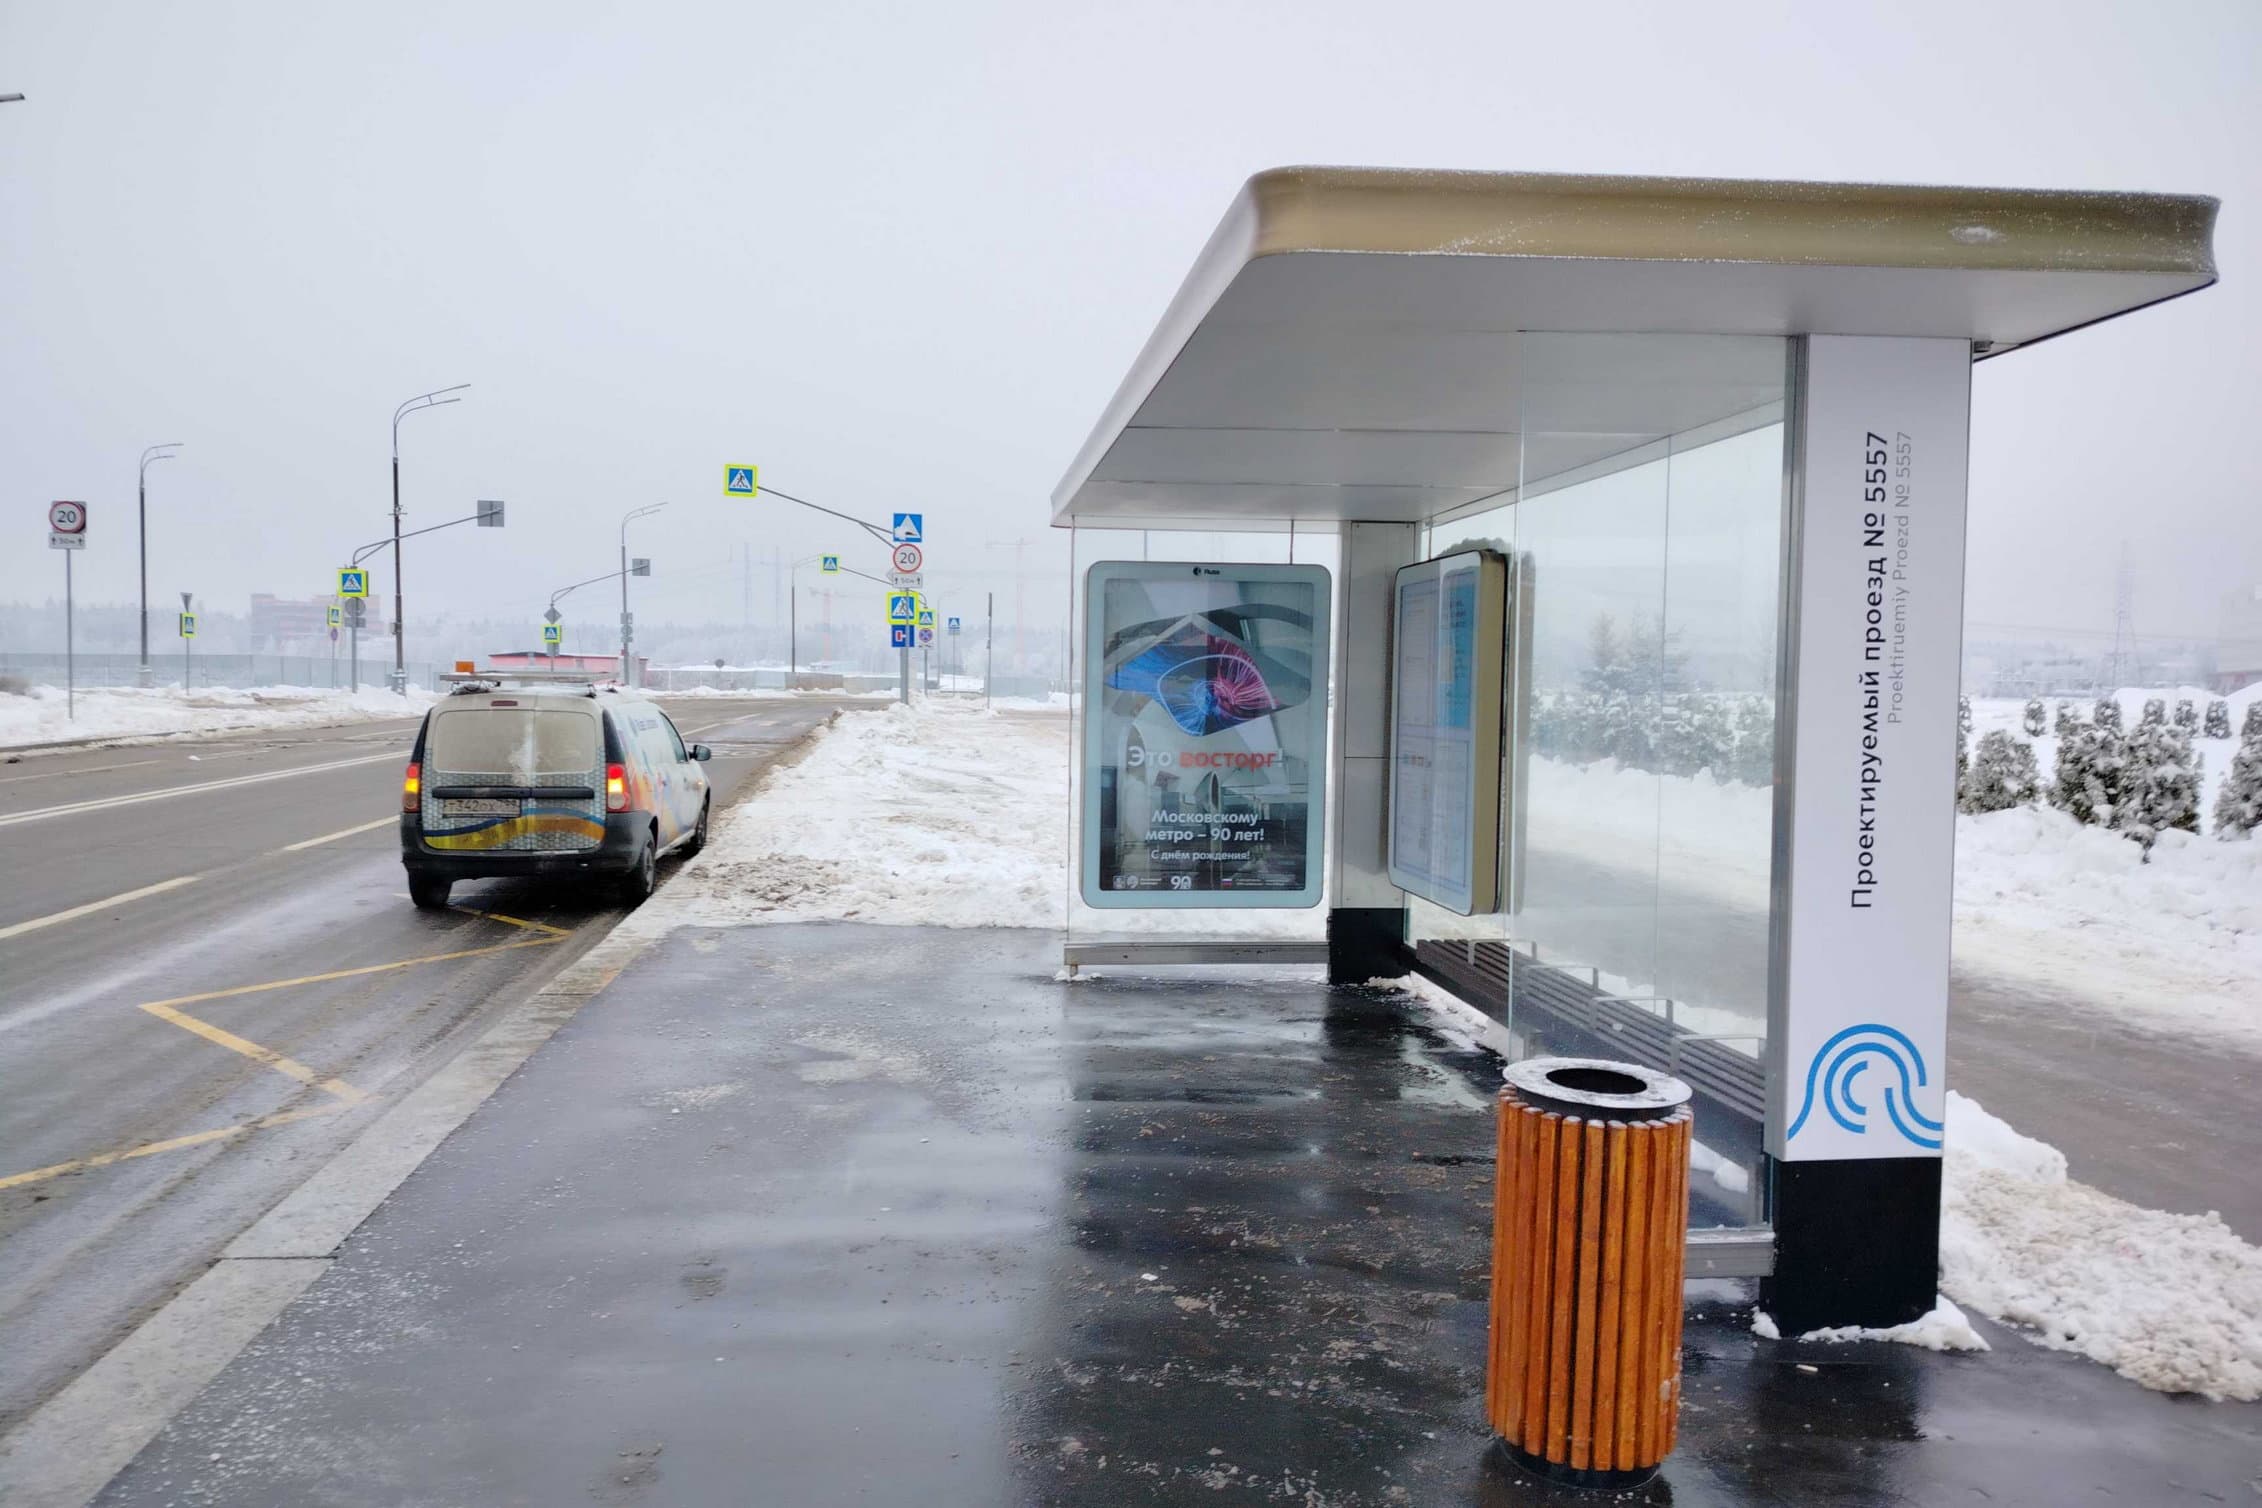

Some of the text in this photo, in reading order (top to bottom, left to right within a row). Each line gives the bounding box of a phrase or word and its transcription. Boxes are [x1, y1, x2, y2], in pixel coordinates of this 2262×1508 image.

[57, 510, 77, 523] 20
[900, 552, 916, 564] 20
[1887, 431, 1912, 724] Proektiruemiy Proezd № 5557
[1851, 431, 1888, 907] Проектируемый проезд № 5557
[1127, 745, 1284, 773] Это восторг!
[1151, 810, 1259, 826] Московскому
[1145, 830, 1194, 843] метро
[1210, 828, 1231, 841] 90
[1234, 828, 1265, 841] лет!
[1151, 850, 1250, 861] С днём рождения!
